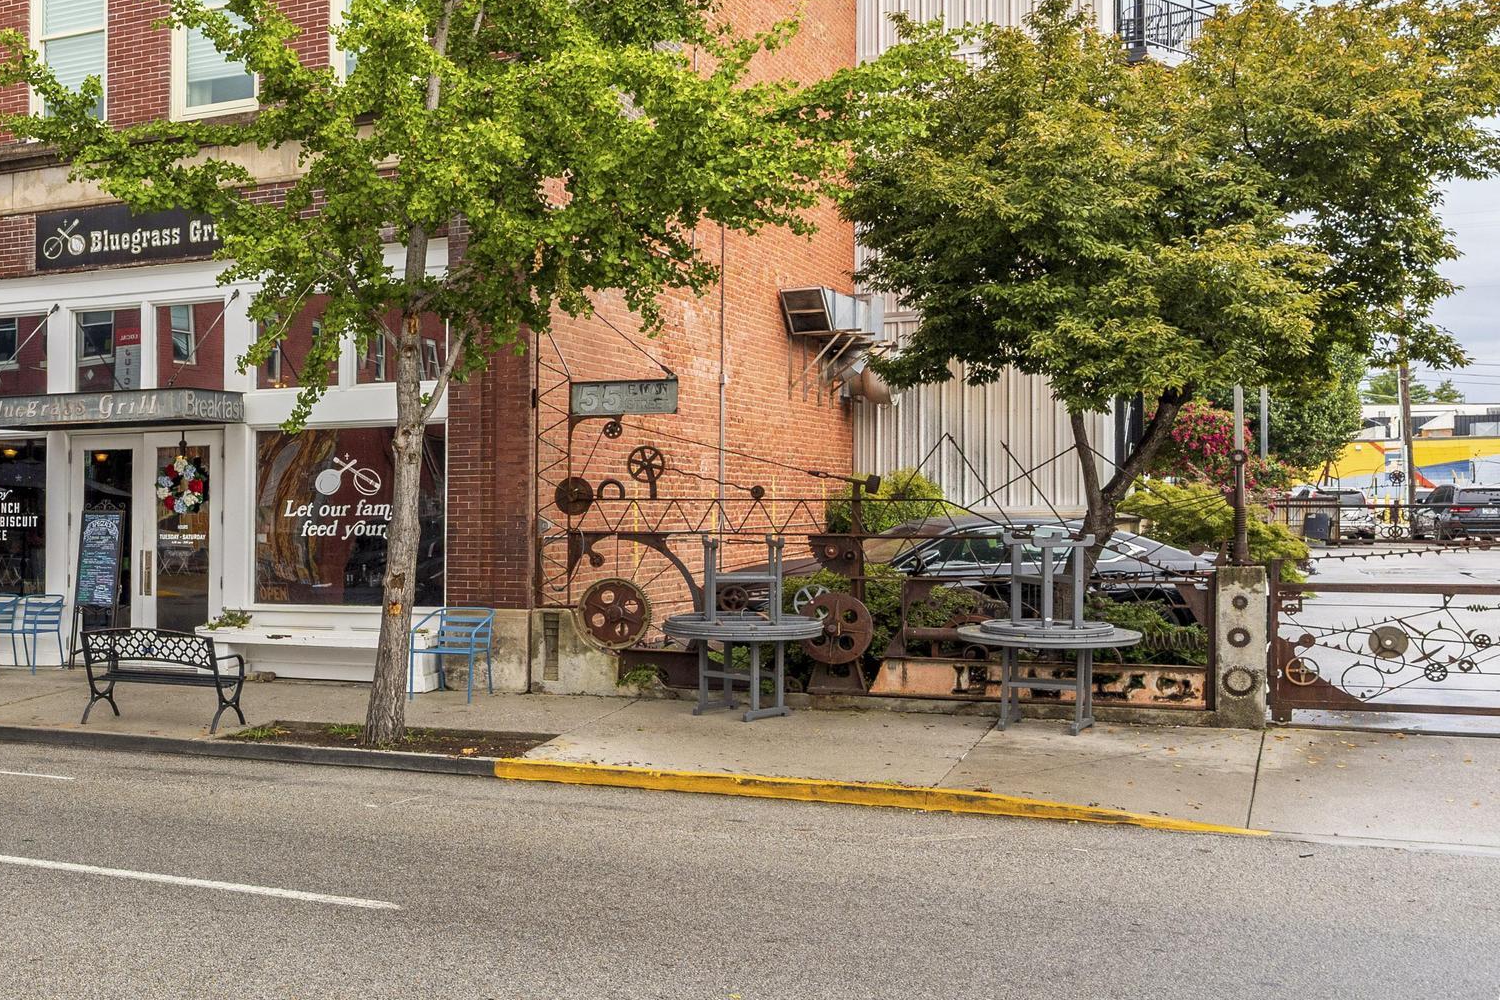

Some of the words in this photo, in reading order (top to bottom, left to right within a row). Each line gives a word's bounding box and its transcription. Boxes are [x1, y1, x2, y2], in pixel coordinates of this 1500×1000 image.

[90, 228, 181, 255] Bluegrass
[189, 219, 219, 243] Gri
[98, 393, 159, 419] Grill
[185, 390, 244, 419] Breakfast
[580, 384, 622, 412] 55
[0, 515, 38, 527] BISCUIT
[284, 499, 315, 517] Let
[319, 504, 351, 517] our
[355, 499, 393, 521] fam
[301, 520, 339, 537] feed
[341, 520, 388, 541] your
[260, 586, 288, 601] OPEN
